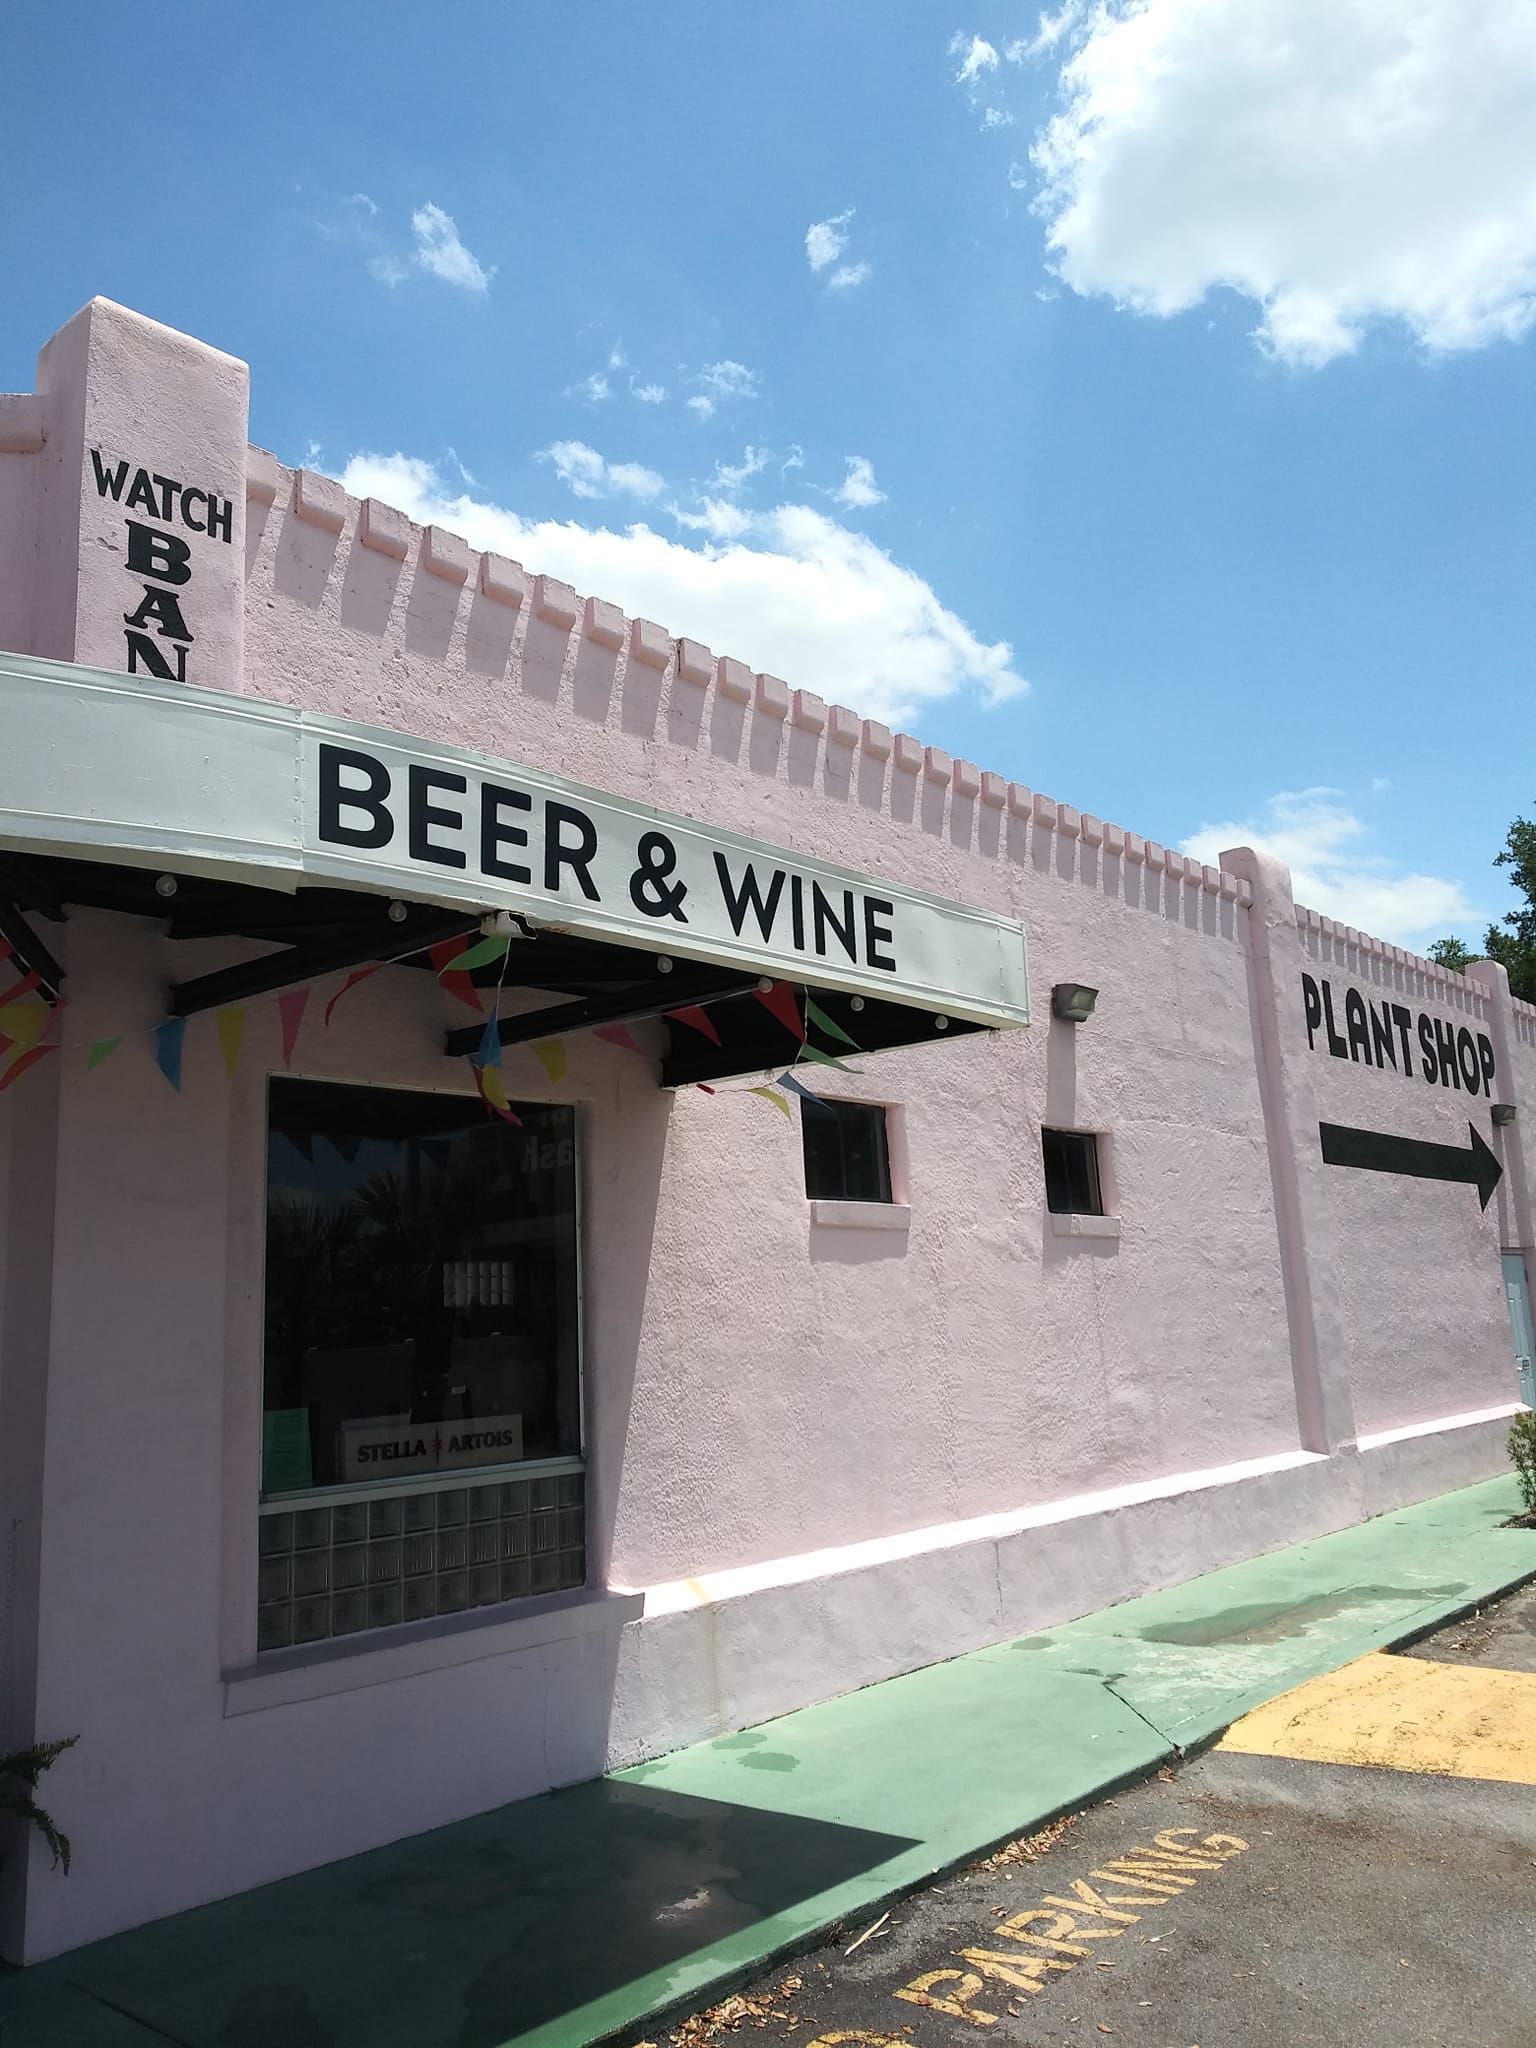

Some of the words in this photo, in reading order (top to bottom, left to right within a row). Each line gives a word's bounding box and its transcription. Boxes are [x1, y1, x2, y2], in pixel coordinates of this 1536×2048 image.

[89, 449, 232, 543] WATCH
[319, 743, 601, 902] BEER
[629, 831, 689, 923] &
[712, 851, 897, 973] WINE
[1301, 972, 1413, 1077] PLANT
[1417, 1012, 1496, 1098] SHOP
[356, 1439, 427, 1463] STELLA
[447, 1430, 513, 1452] ARTOIS
[893, 1827, 1250, 2026] PARKING
